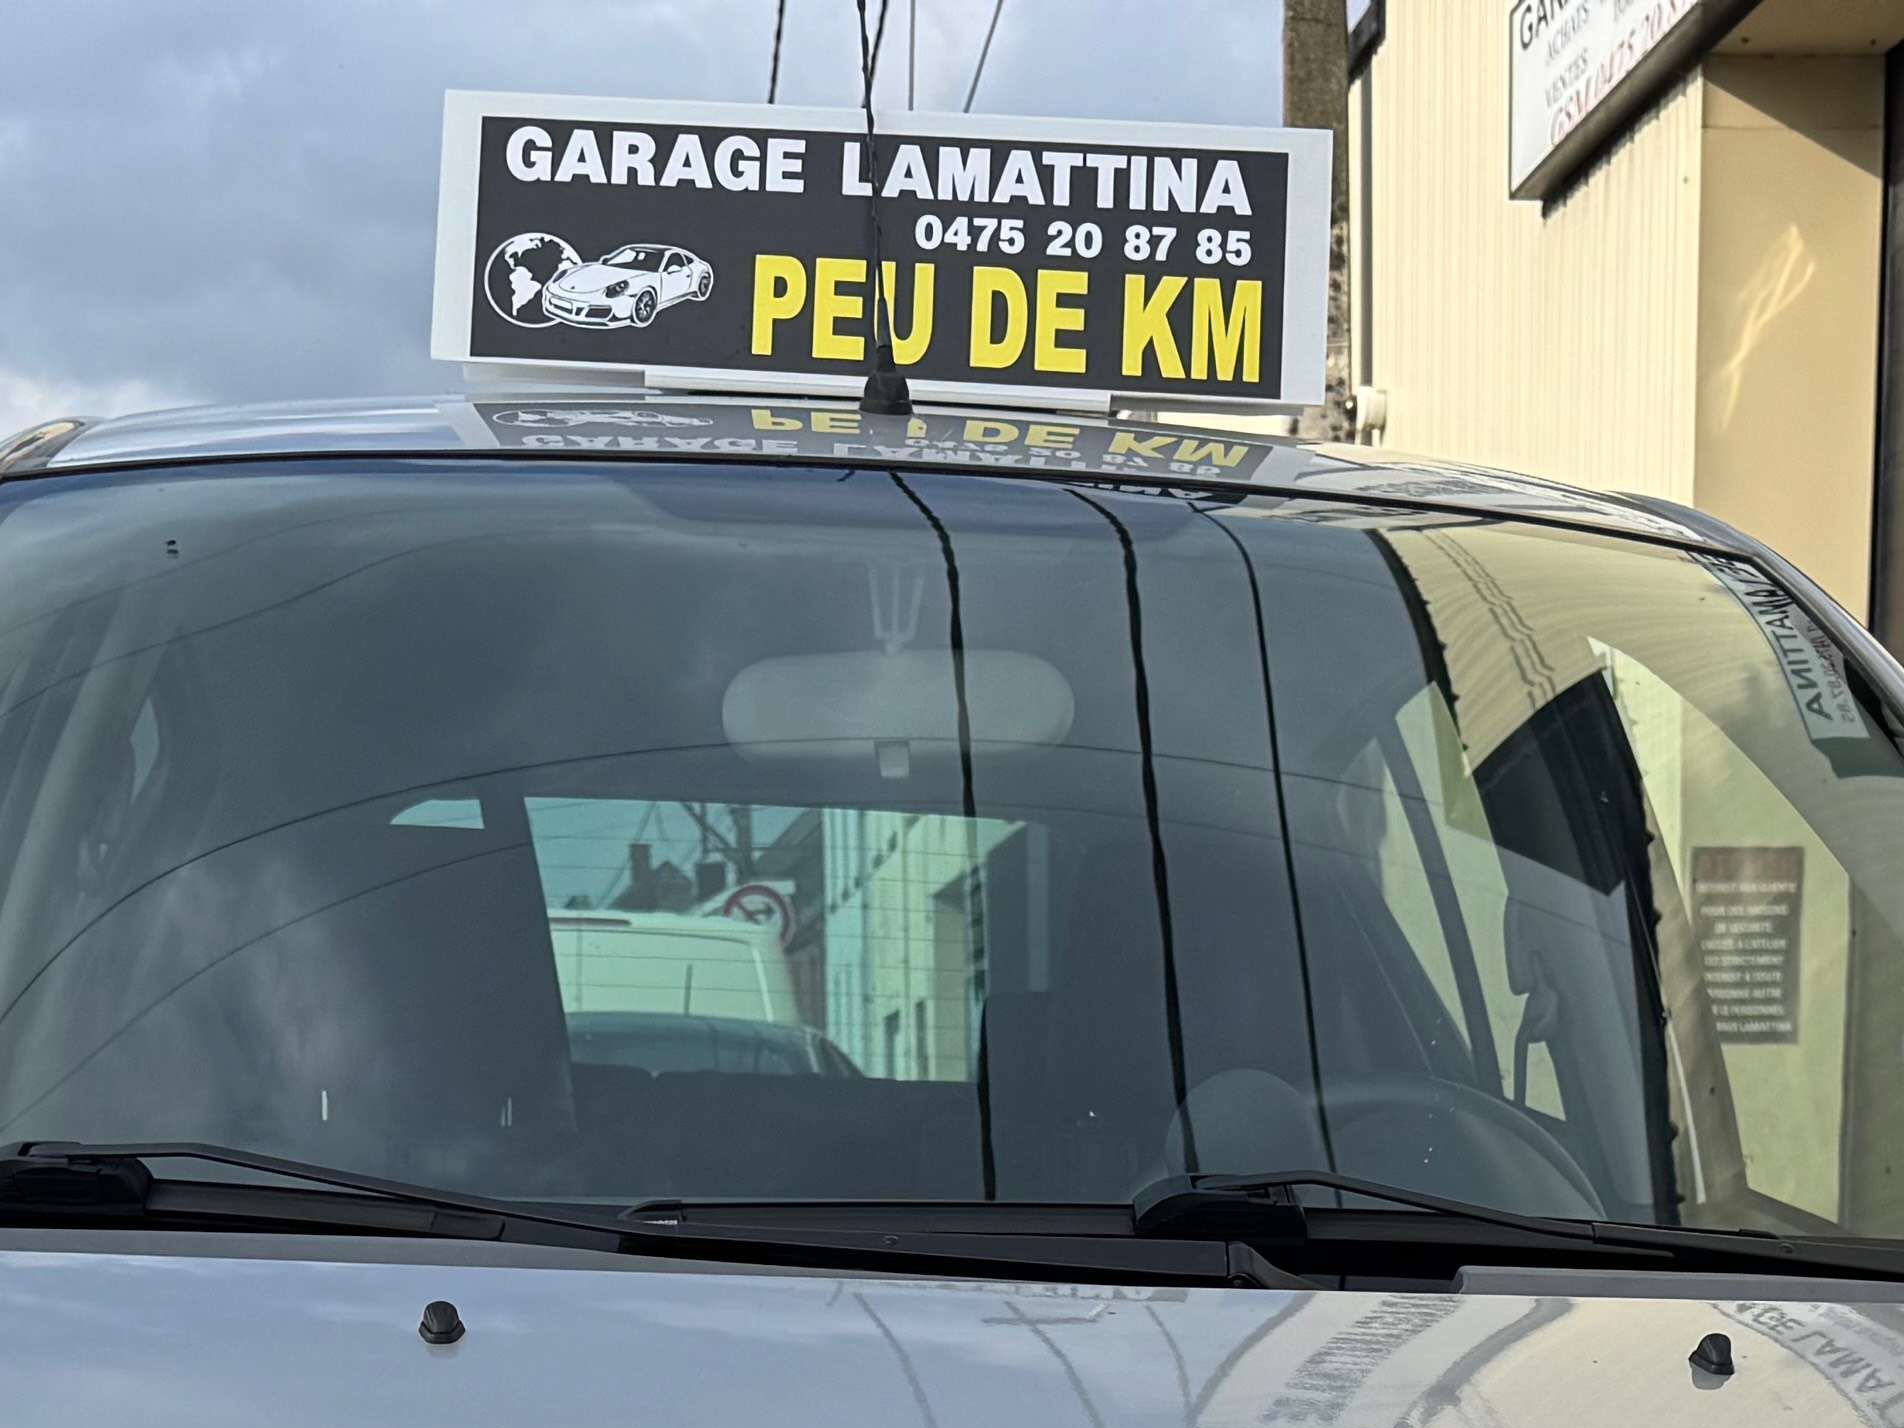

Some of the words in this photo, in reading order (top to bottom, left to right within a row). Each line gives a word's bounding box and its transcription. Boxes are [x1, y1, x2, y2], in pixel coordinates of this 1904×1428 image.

[506, 126, 805, 194] GARAGE
[842, 140, 1253, 216] LAMATTINA
[915, 214, 1025, 256] 0475
[1046, 221, 1103, 260] 20
[1124, 224, 1177, 263] 87
[1196, 228, 1252, 267] 85
[751, 254, 935, 366] PEU
[969, 266, 1089, 375] DE
[1121, 274, 1264, 384] KM
